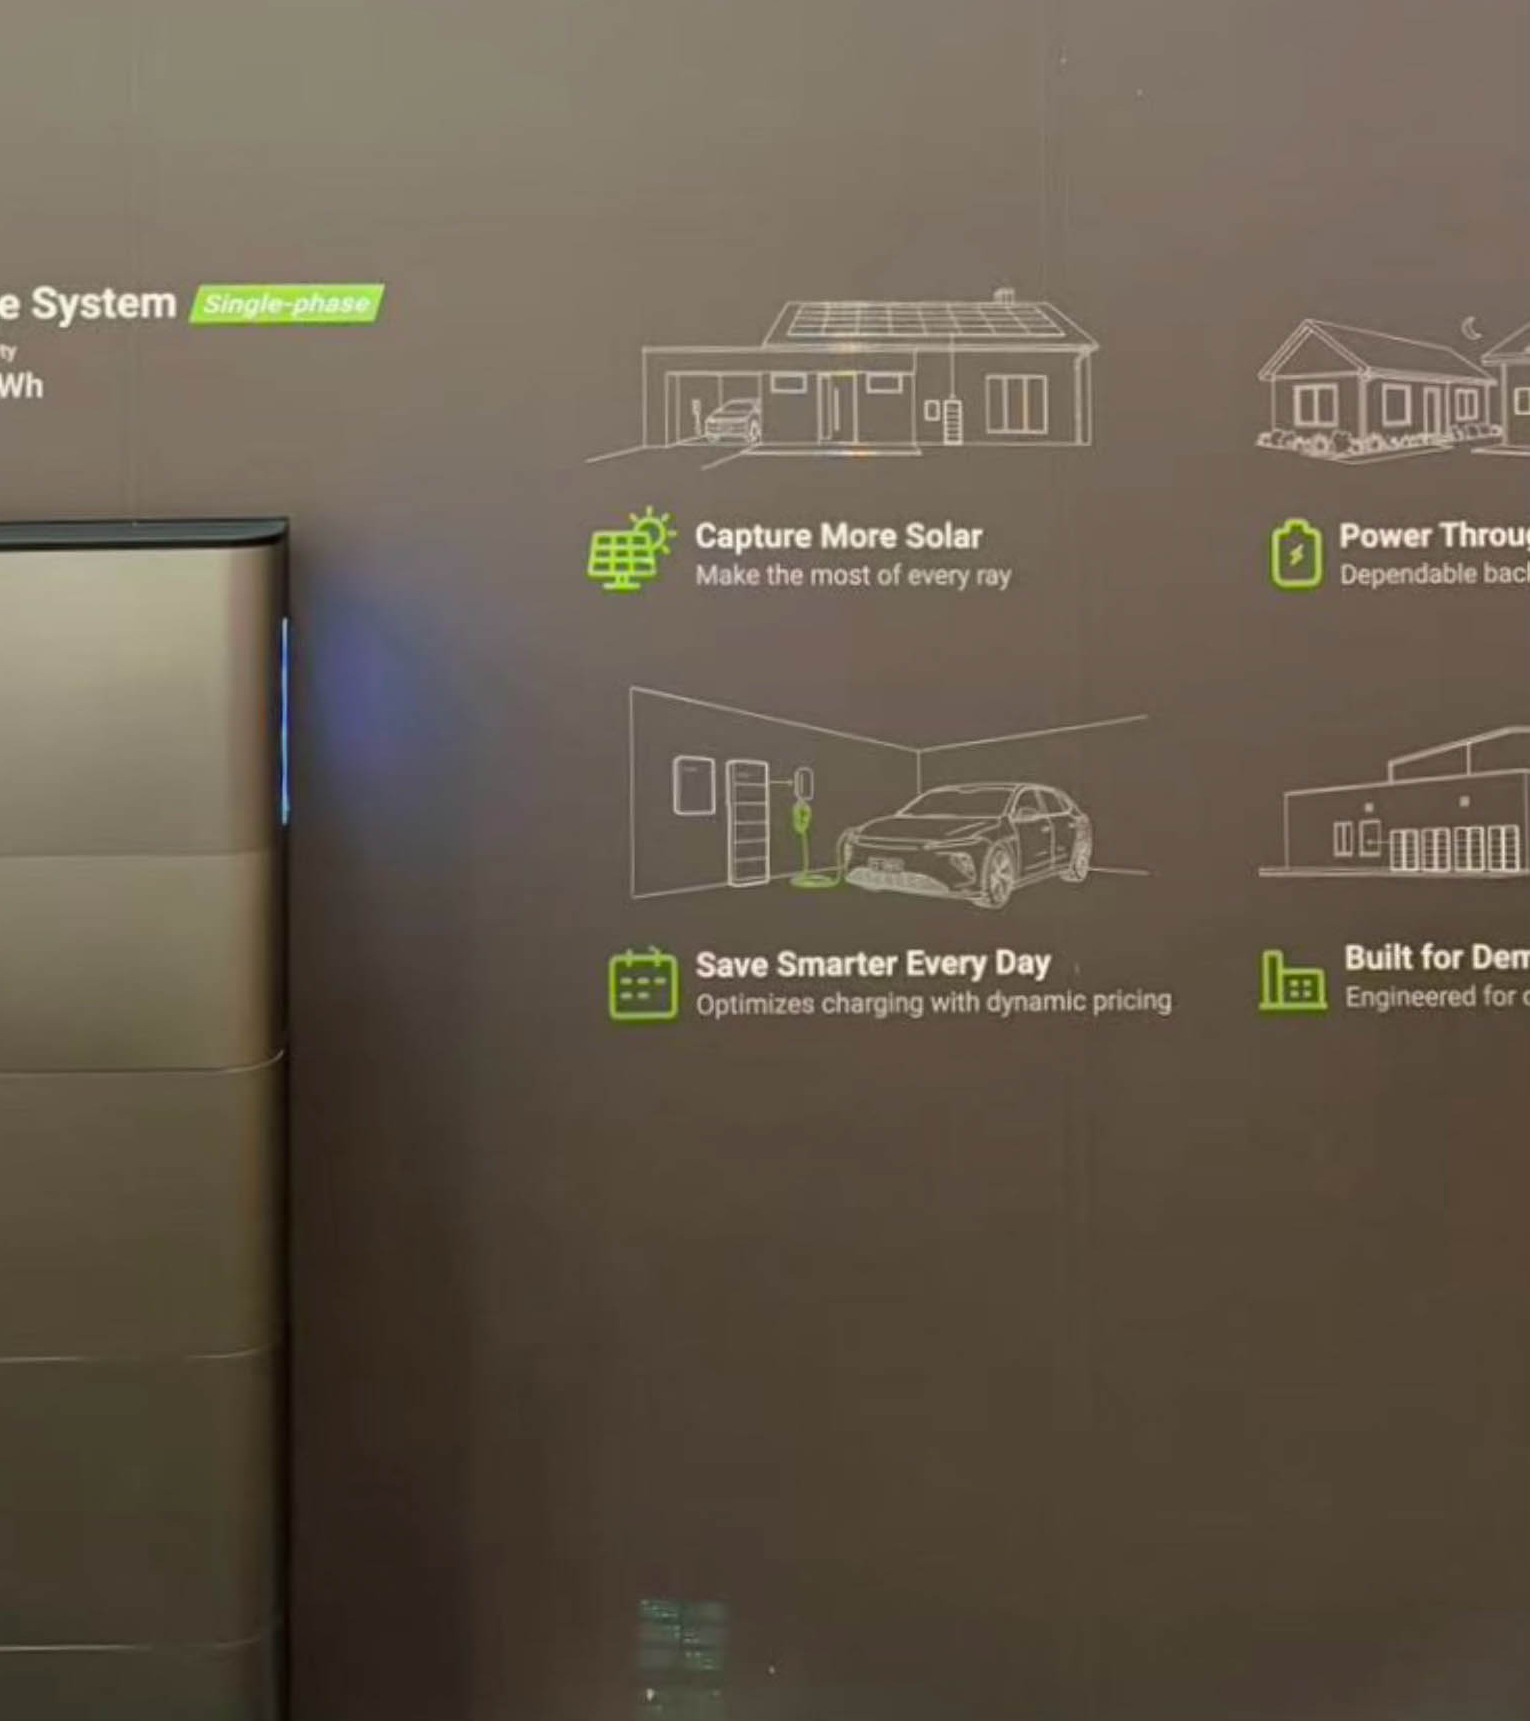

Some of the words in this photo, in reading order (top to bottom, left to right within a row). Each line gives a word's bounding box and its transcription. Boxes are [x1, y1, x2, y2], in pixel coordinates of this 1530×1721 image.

[31, 285, 177, 328] System
[203, 293, 370, 318] Single-phase
[695, 521, 813, 556] Capture
[820, 521, 898, 549] More
[905, 521, 984, 549] Solar
[695, 563, 761, 586] Make
[766, 562, 804, 586] the
[810, 565, 871, 586] most
[877, 562, 902, 586] of
[907, 568, 971, 592] every
[976, 568, 1012, 591] ray
[696, 951, 769, 978] Save
[777, 950, 899, 978] Smarter
[906, 949, 988, 983] Every
[995, 948, 1052, 982] Day
[696, 992, 815, 1020] Optimizes
[821, 990, 925, 1019] charging
[929, 990, 981, 1013] with
[985, 989, 1087, 1018] dynamic
[1092, 989, 1173, 1016] pricing
